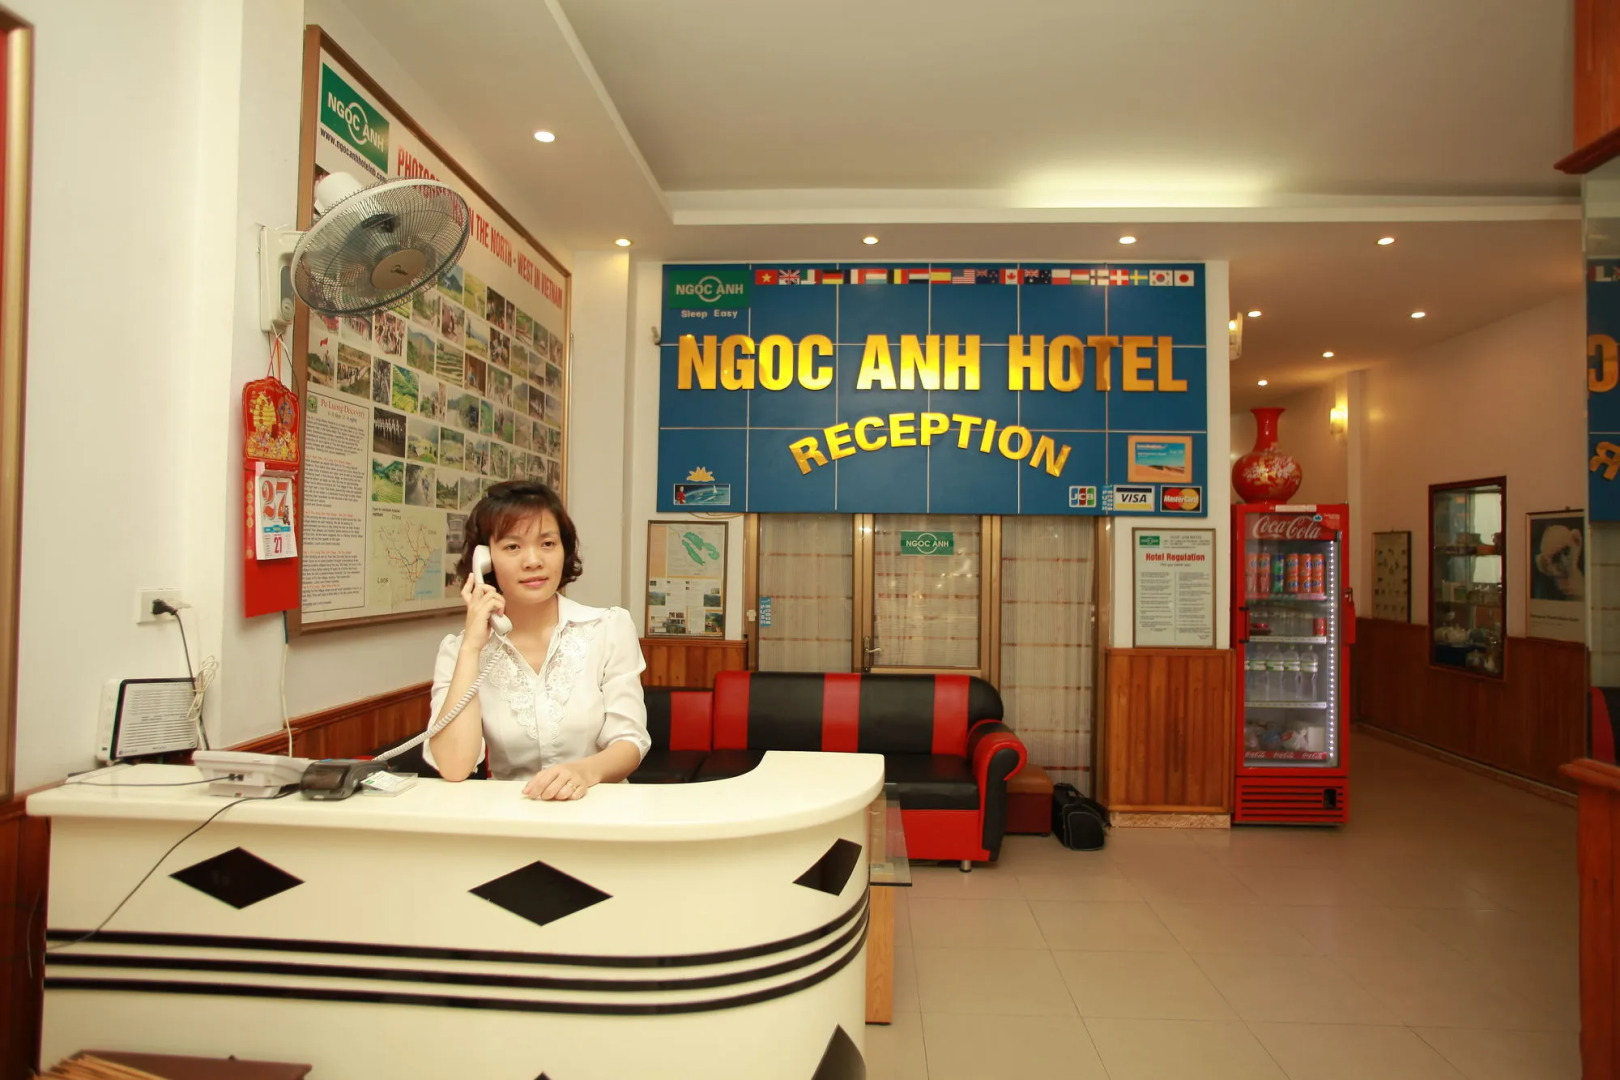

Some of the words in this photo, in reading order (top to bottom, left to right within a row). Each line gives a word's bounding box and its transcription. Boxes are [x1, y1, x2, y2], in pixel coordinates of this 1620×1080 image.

[328, 91, 360, 131] NGOC
[362, 123, 384, 152] ANH
[476, 213, 489, 249] THE
[490, 226, 513, 268] NORTH
[517, 250, 534, 285] WEST
[533, 265, 541, 292] IN
[541, 271, 562, 310] VIETNAM
[676, 284, 713, 295] NGOC
[716, 283, 744, 295] ANH
[681, 309, 708, 319] Sleep
[713, 309, 738, 319] Easy
[677, 334, 833, 391] NGOC
[856, 334, 981, 391] ANH
[1008, 335, 1188, 392] HOTEL
[788, 412, 1072, 478] RECEPTION
[1070, 492, 1094, 502] JCB
[1120, 494, 1147, 503] VISA
[1163, 495, 1199, 504] MasterCard
[1145, 553, 1164, 561] Hotel
[1166, 553, 1206, 562] Regulation
